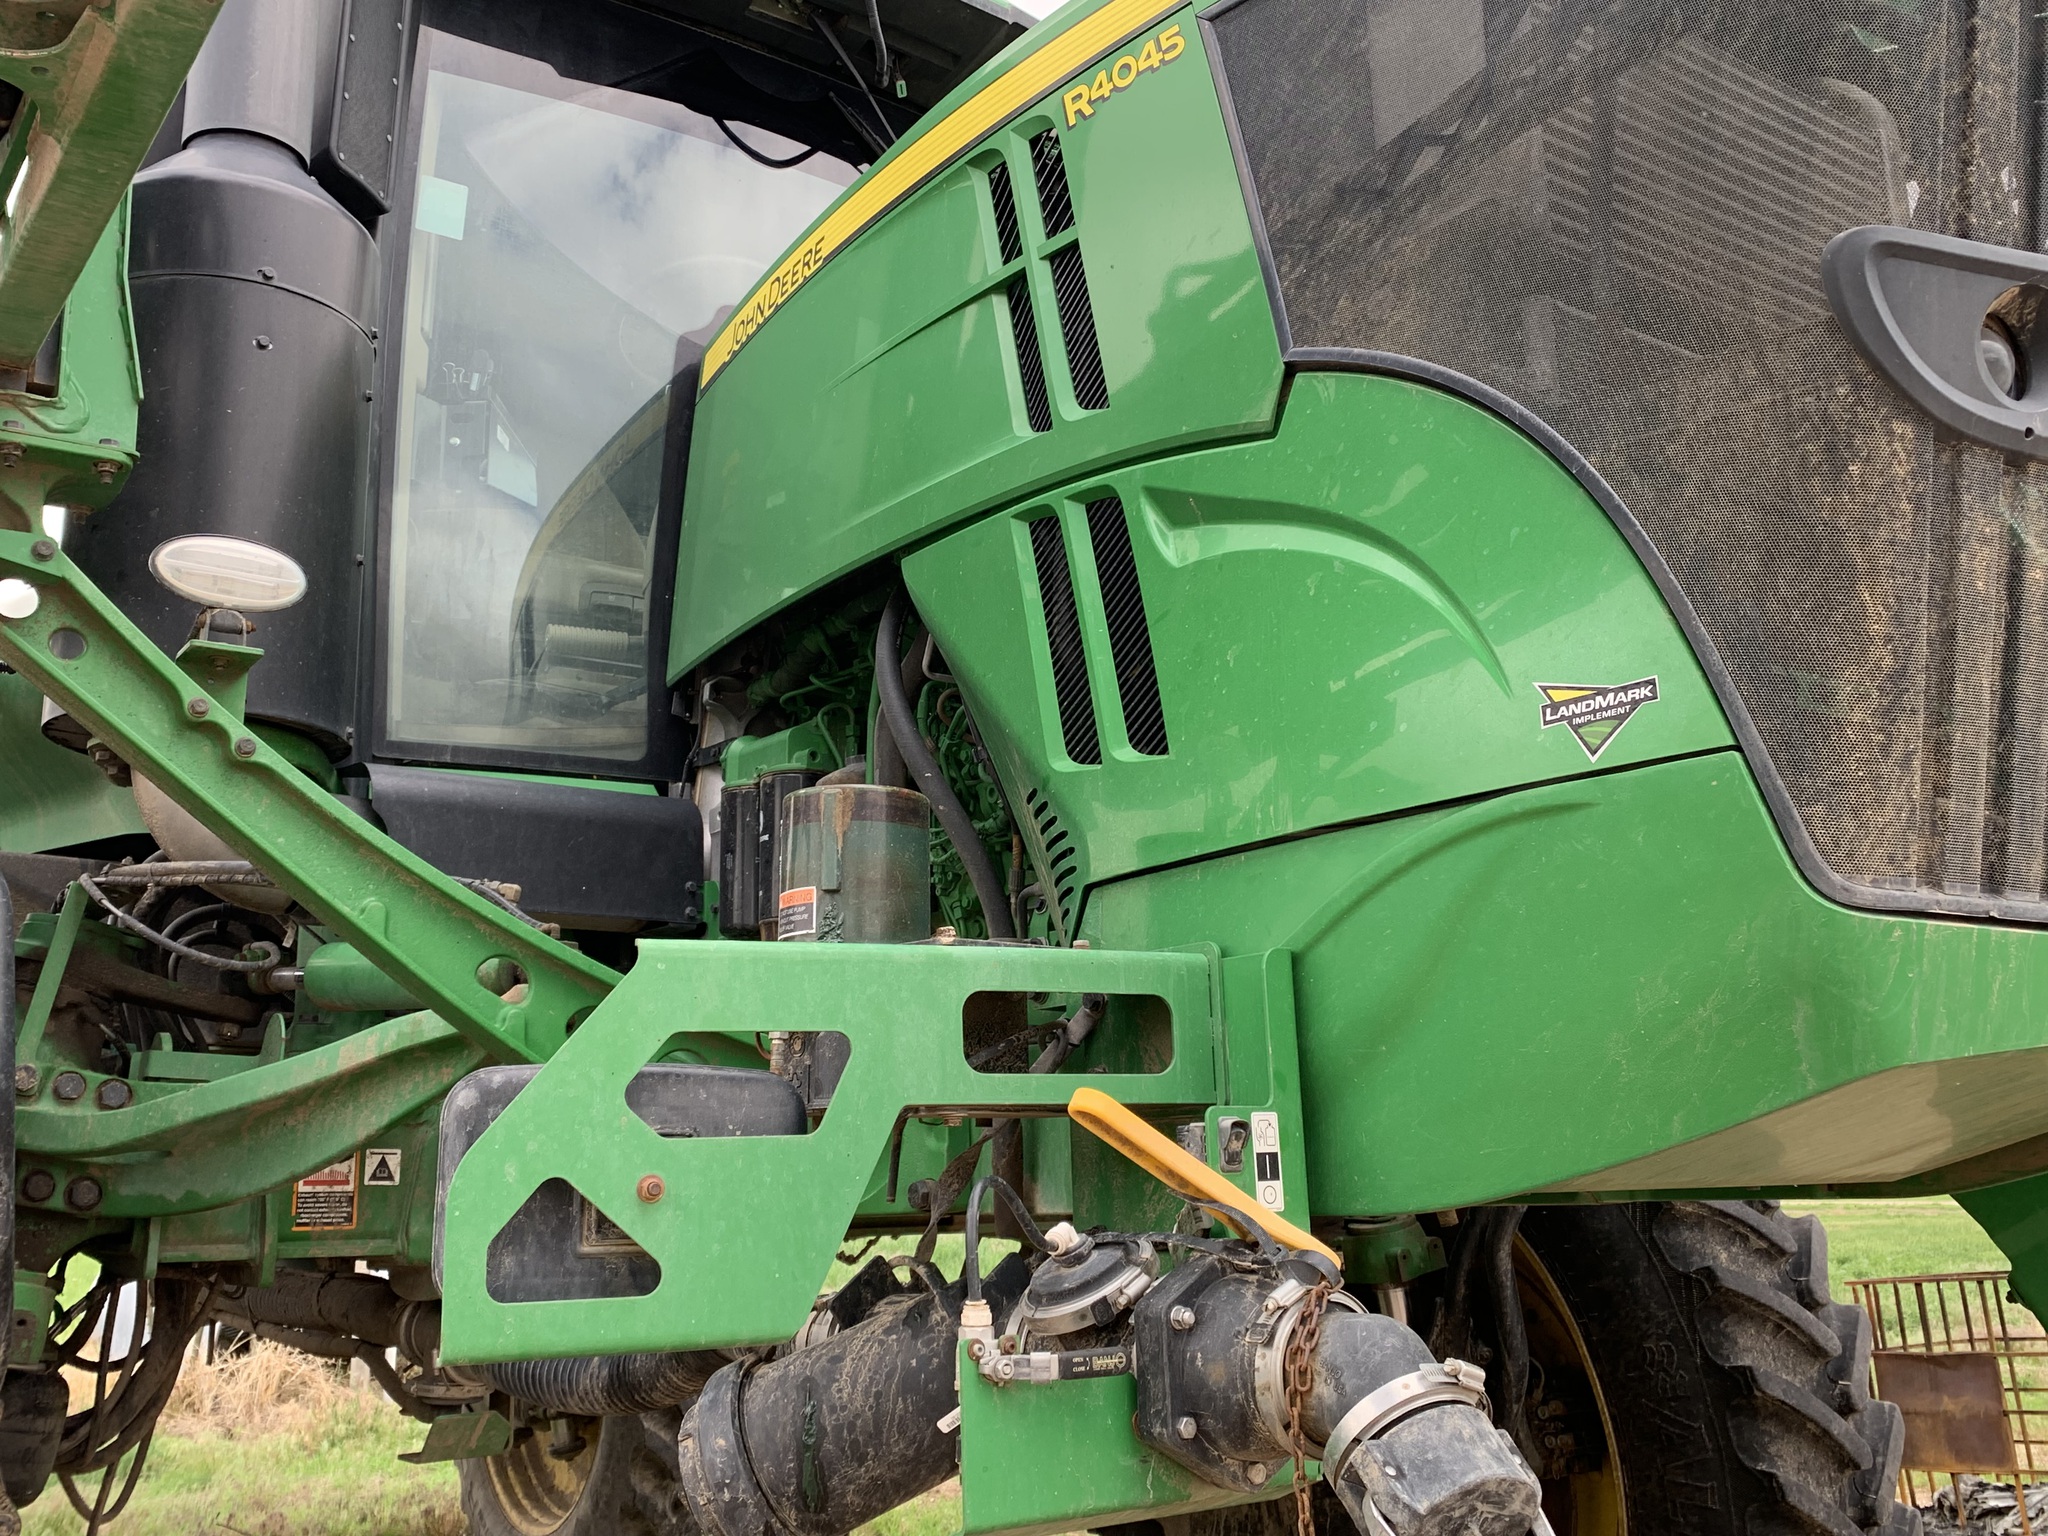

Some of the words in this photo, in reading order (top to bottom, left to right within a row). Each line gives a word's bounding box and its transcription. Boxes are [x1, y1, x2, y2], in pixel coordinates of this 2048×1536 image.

[1062, 23, 1186, 131] R4045
[726, 293, 767, 357] JOHN
[768, 235, 825, 311] DEERE
[1545, 684, 1654, 721] LANDMARK
[1572, 704, 1631, 725] IMPLEMENT
